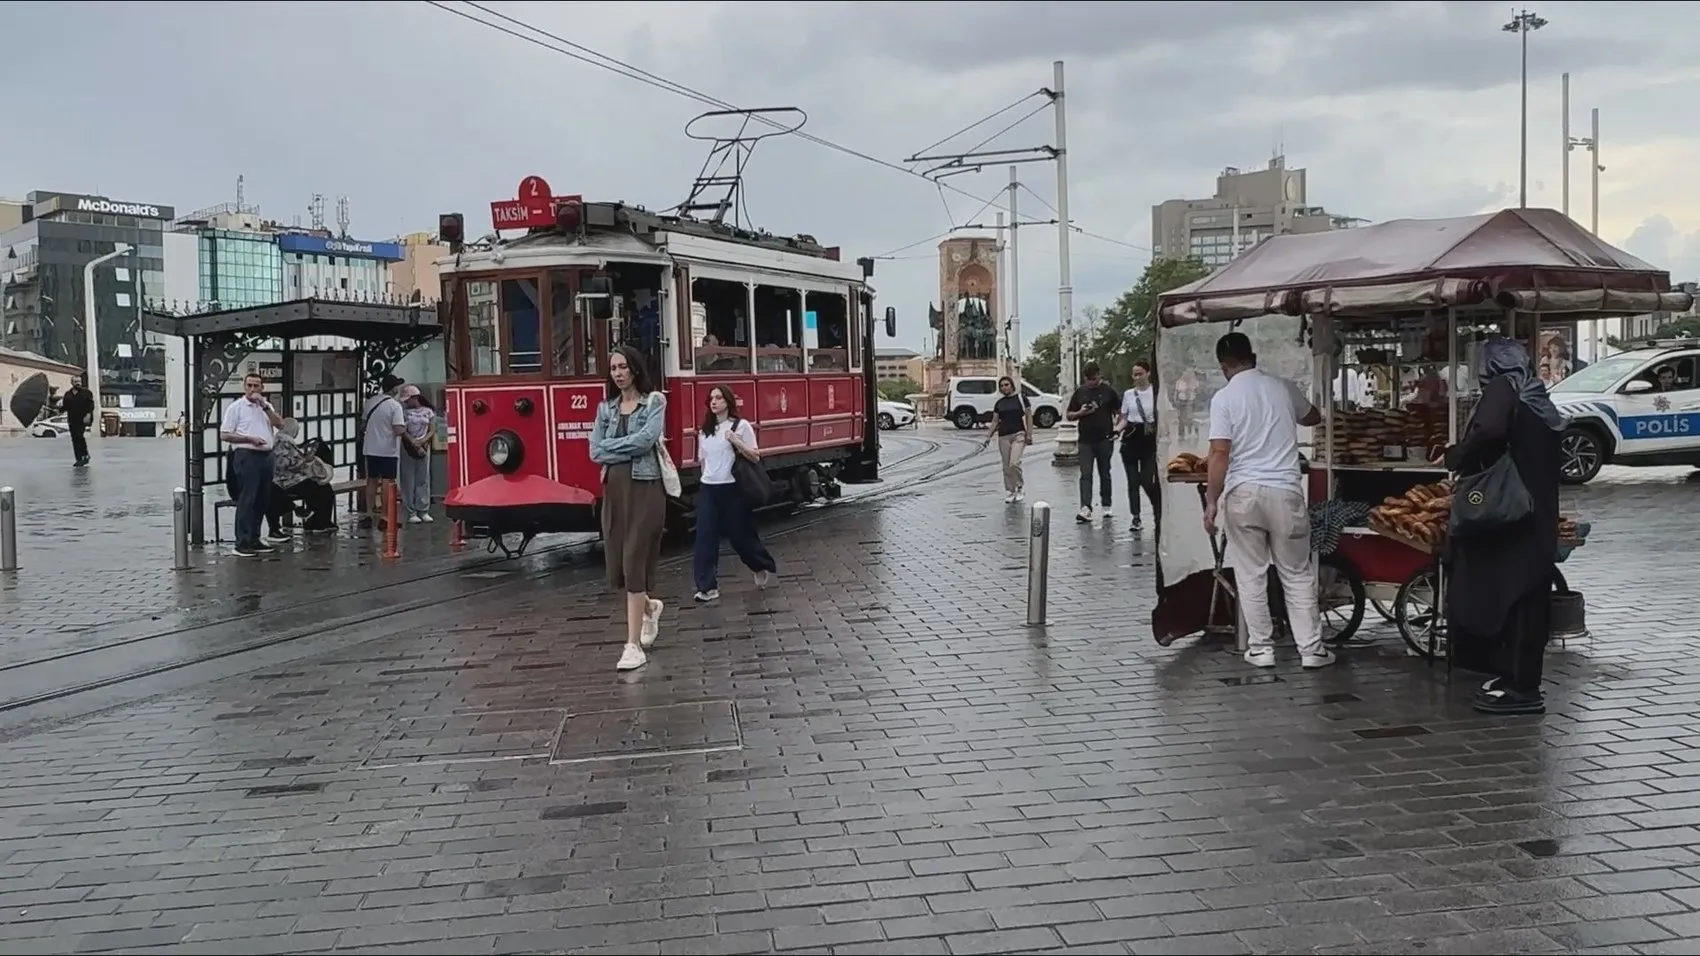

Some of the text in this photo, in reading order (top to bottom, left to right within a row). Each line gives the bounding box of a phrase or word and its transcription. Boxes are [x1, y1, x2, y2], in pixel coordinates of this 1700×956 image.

[530, 179, 538, 196] 2
[78, 199, 159, 217] McDonald's
[494, 203, 529, 222] TAKSİM
[571, 394, 588, 409] 223
[119, 410, 157, 420] onald's
[1636, 415, 1690, 435] POLİS
